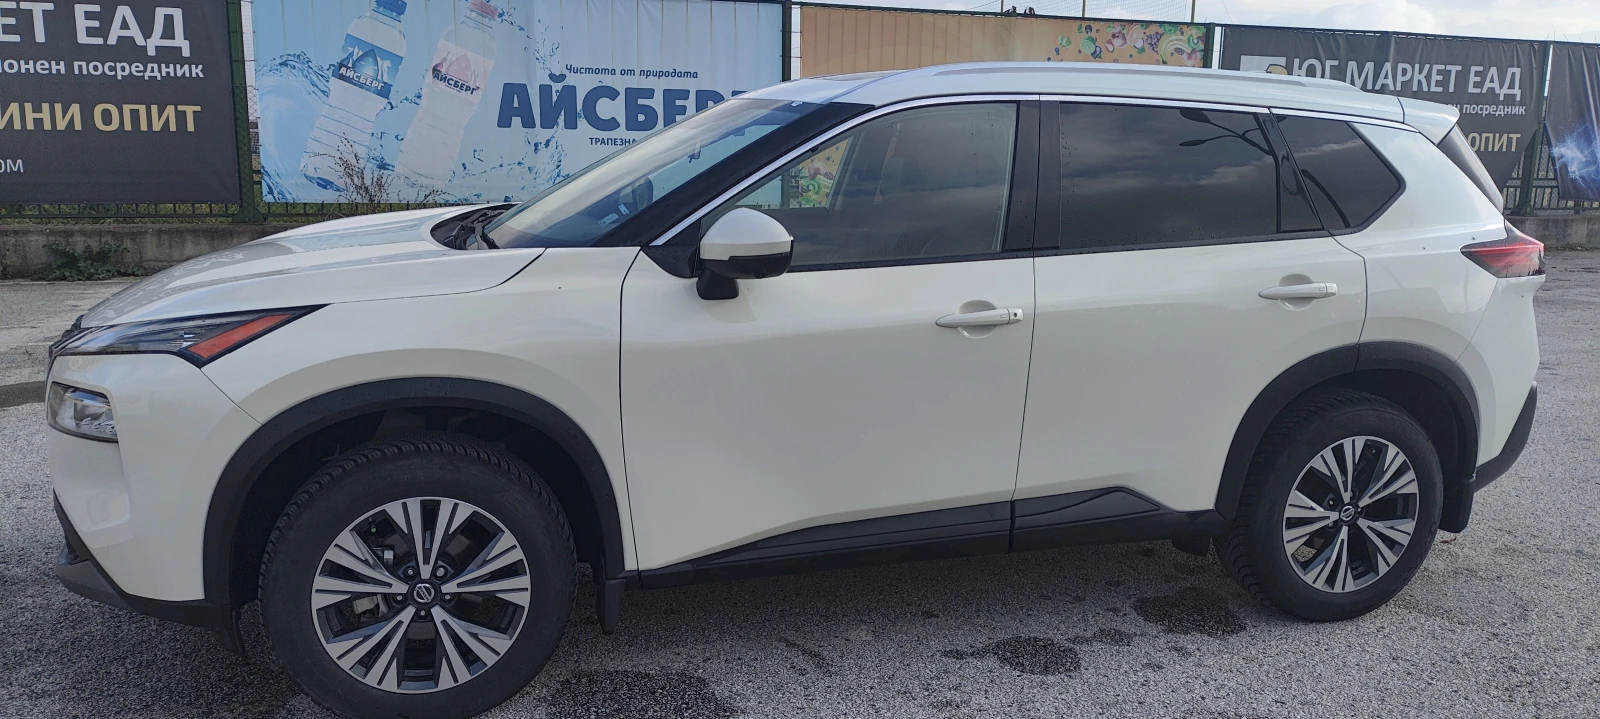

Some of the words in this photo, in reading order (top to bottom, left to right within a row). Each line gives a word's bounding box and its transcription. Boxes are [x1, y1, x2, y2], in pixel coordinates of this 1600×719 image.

[74, 3, 191, 57] ЕАД
[0, 59, 66, 75] онен
[73, 60, 204, 80] посредник
[338, 66, 385, 90] АЙСБЕРГ
[565, 64, 617, 76] Чистота
[620, 68, 636, 77] от
[639, 69, 699, 79] природата
[1292, 57, 1340, 79] ЮГ
[1345, 60, 1463, 93] МАРКЕТ
[1467, 66, 1522, 102] ЕАД
[432, 73, 477, 95] АЙСБЕРГ
[497, 73, 751, 132] АЙСБЕ
[1462, 104, 1526, 117] посредник
[93, 103, 202, 132] ОПИТ
[1467, 132, 1522, 152] ОПИТ
